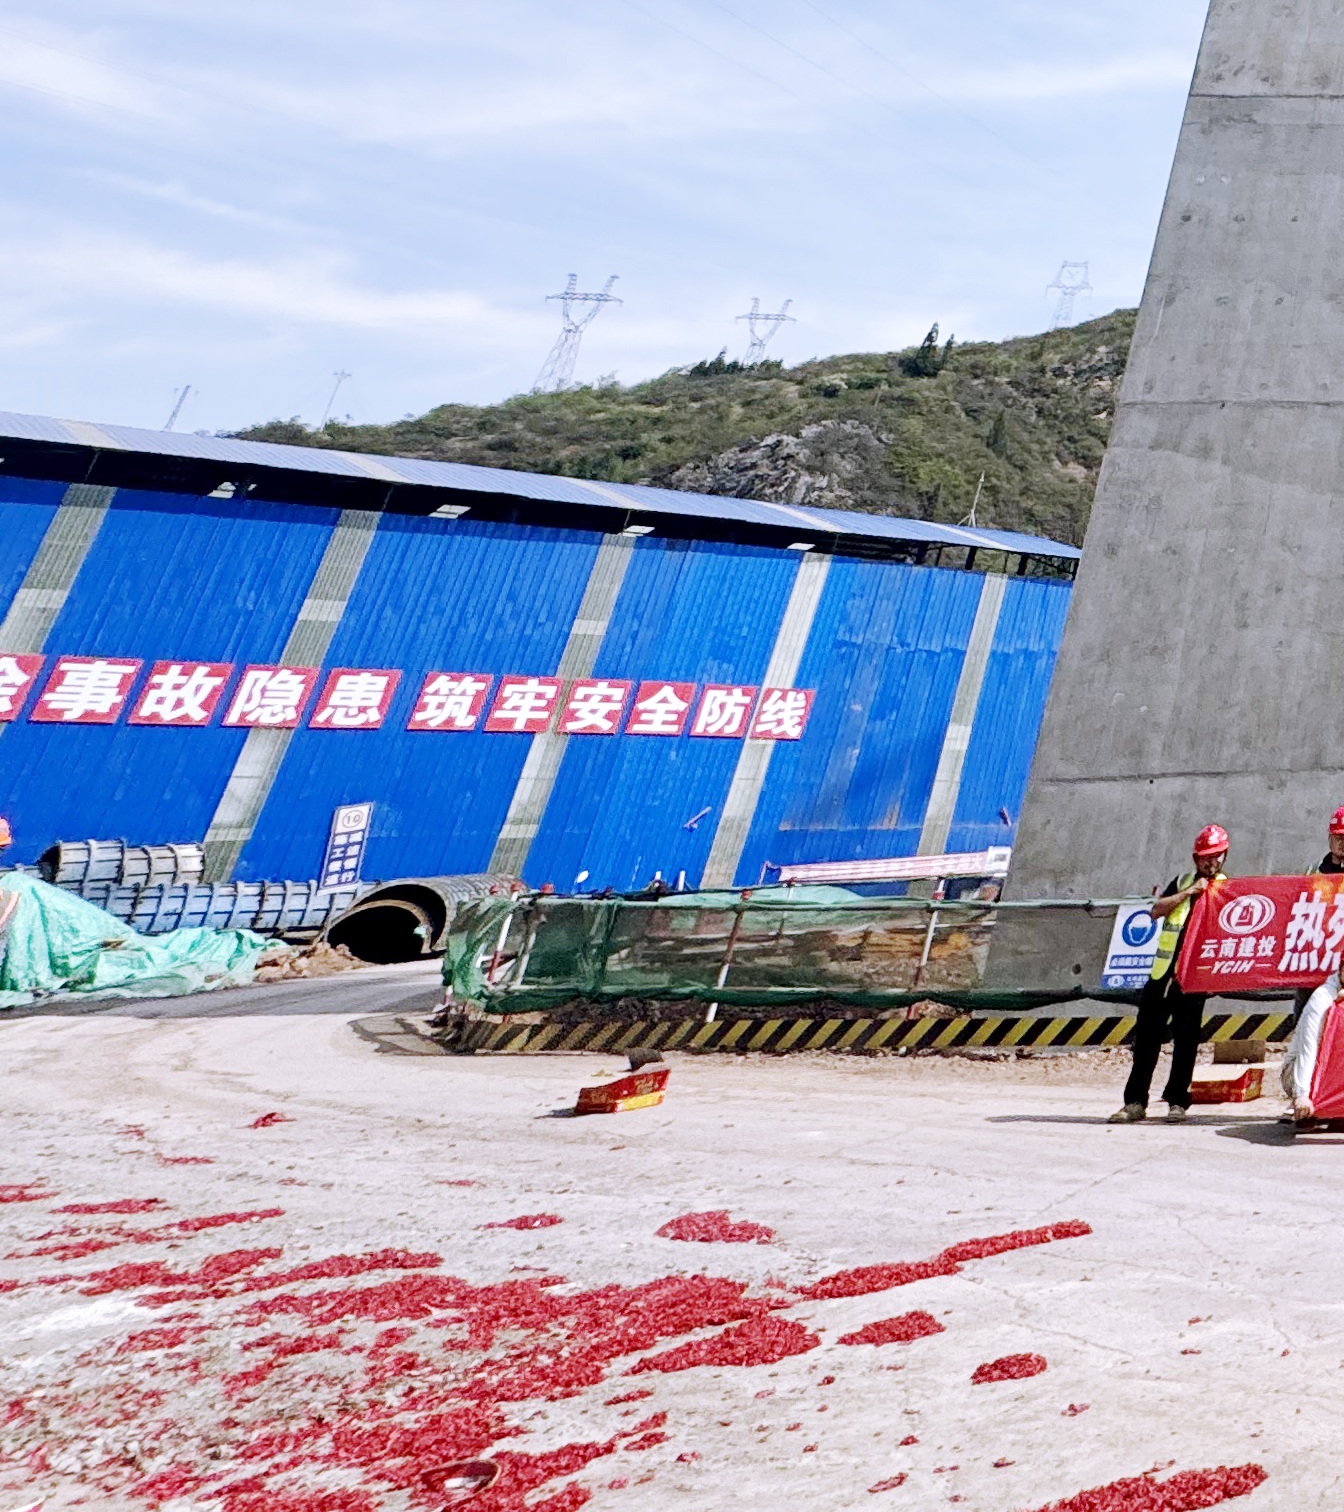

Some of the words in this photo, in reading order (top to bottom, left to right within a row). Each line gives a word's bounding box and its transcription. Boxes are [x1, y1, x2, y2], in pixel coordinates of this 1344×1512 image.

[413, 674, 809, 738] 筑牢安全防线
[1201, 935, 1277, 958] 云南建投
[1211, 960, 1255, 974] YCIH
